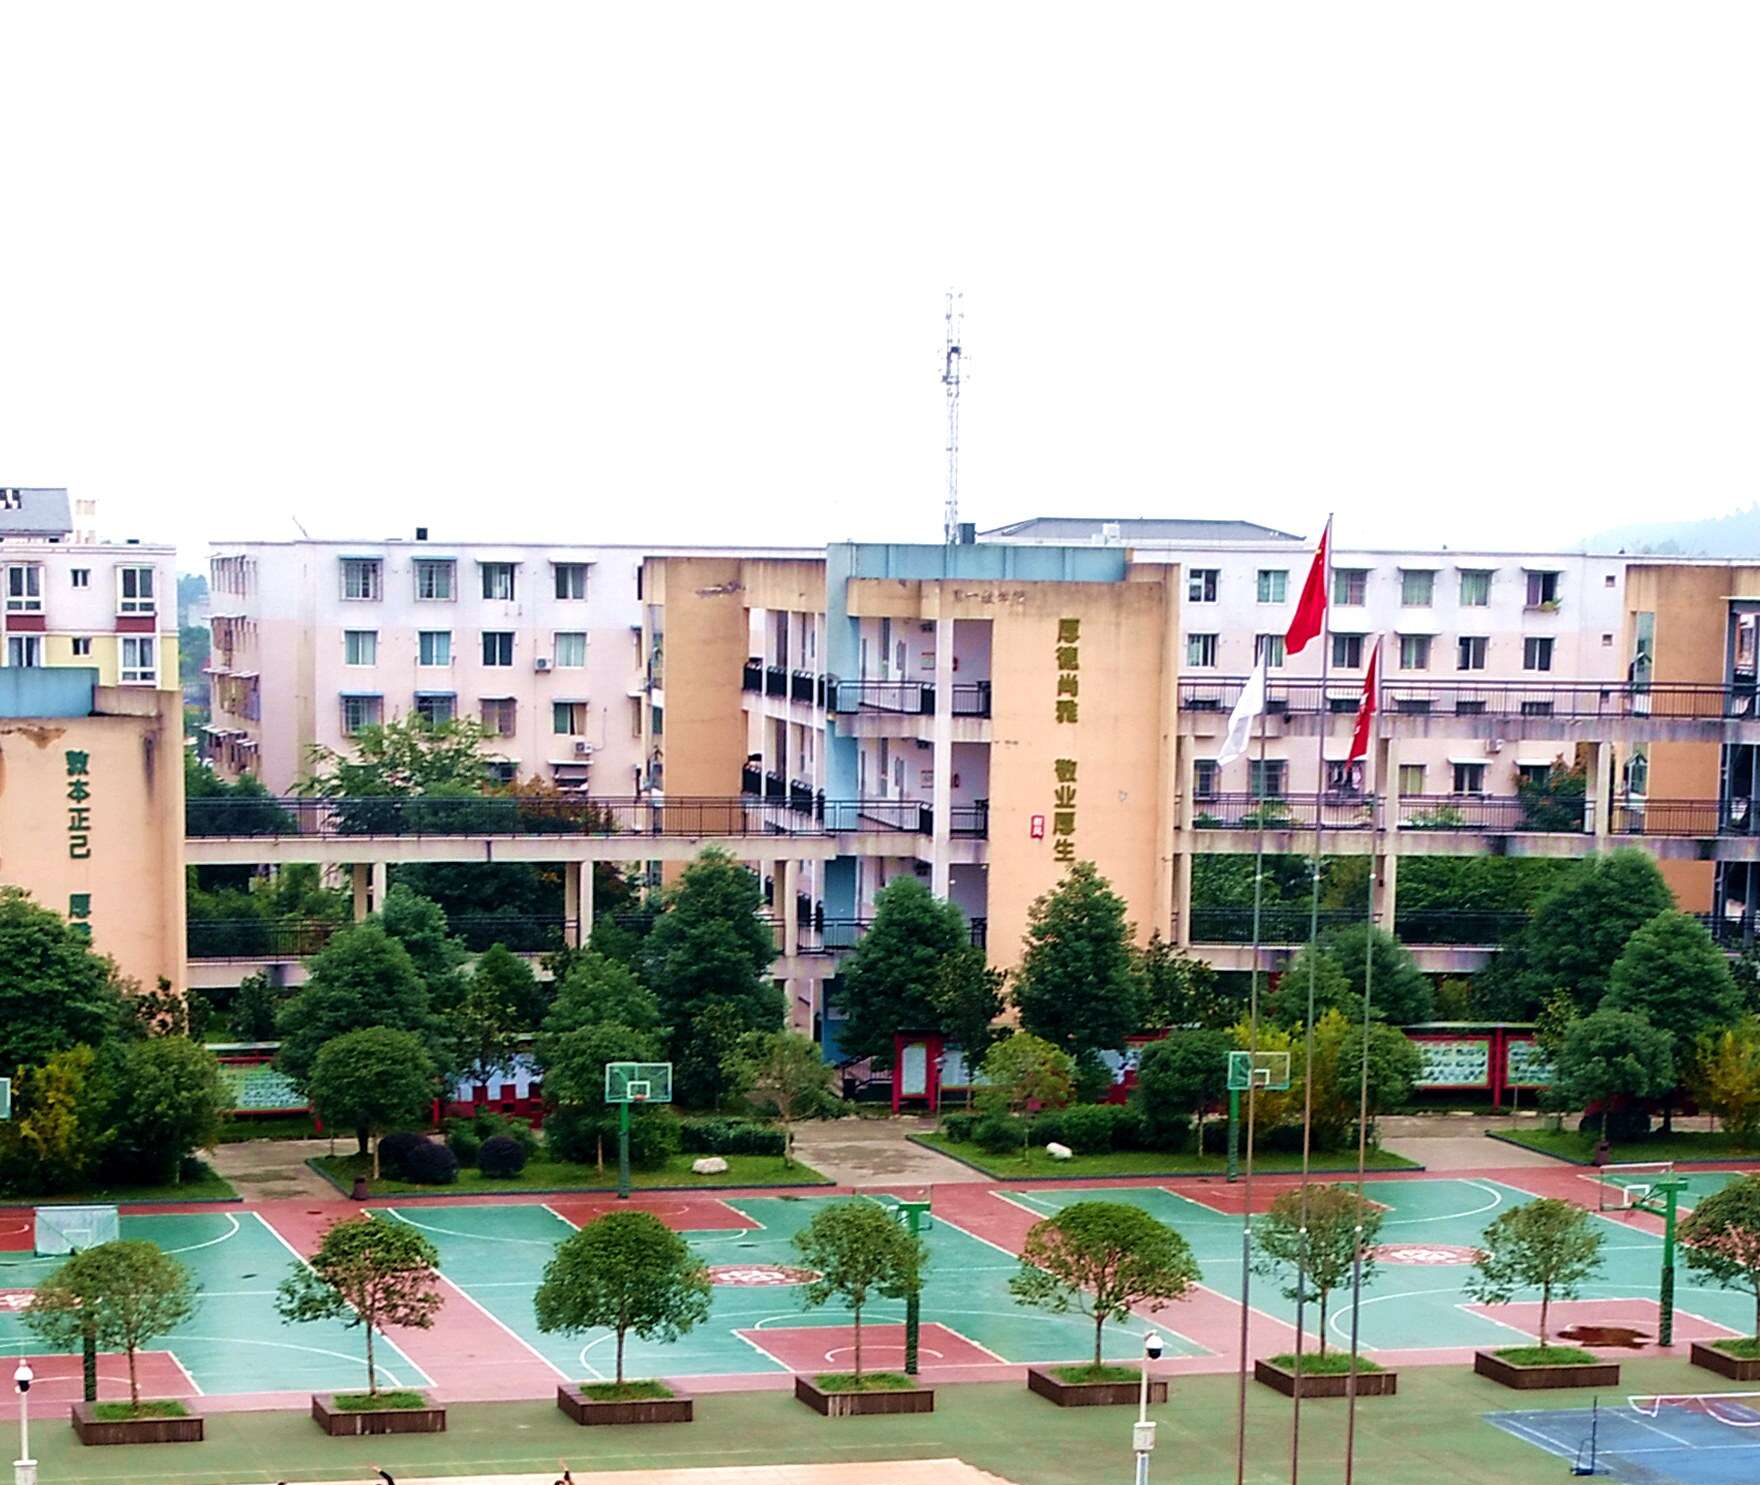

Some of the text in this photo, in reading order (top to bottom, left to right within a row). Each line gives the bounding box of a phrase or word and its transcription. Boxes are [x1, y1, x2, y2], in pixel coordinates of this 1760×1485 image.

[1053, 618, 1080, 862] 厚德尚雅 敬业厚生
